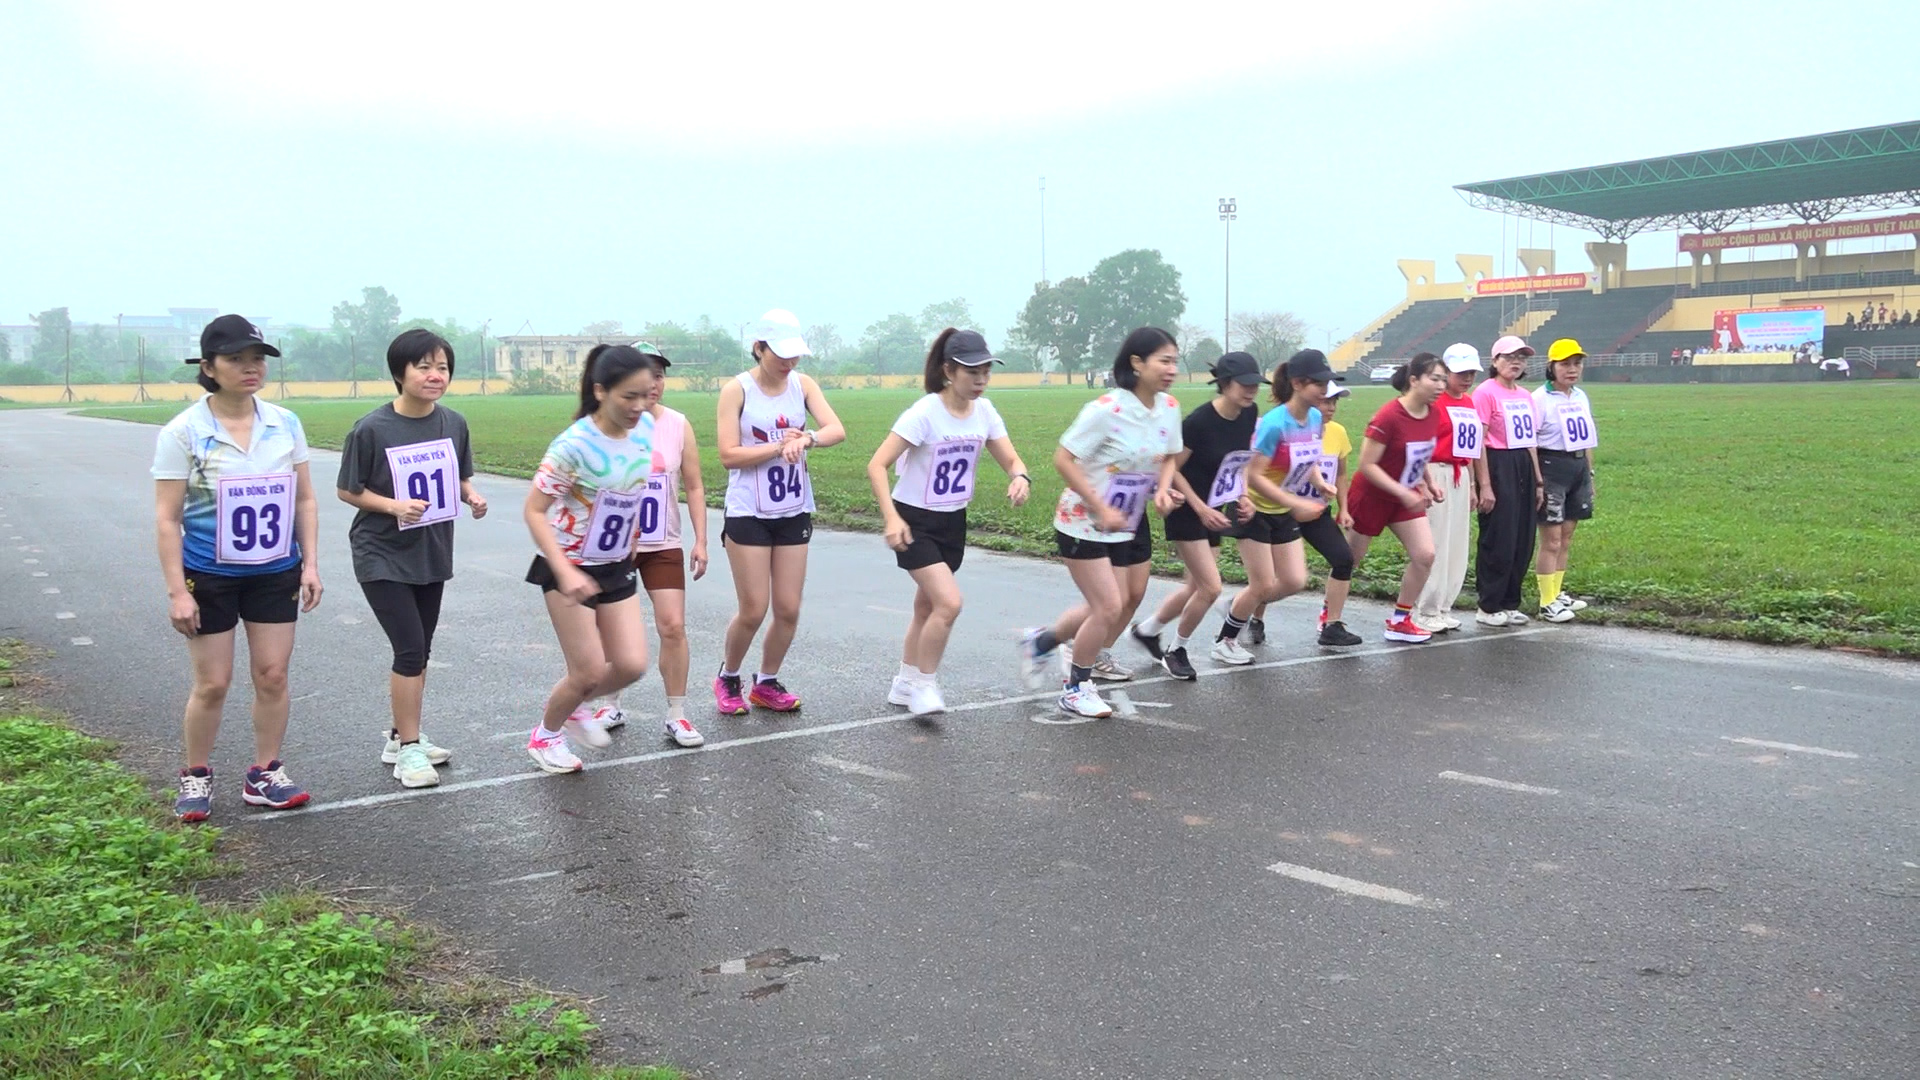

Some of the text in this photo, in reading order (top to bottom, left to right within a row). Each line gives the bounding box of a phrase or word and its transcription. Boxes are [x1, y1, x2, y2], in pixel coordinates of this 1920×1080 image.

[1729, 234, 1755, 246] CỘNG
[1757, 231, 1777, 243] HOÀ
[1795, 227, 1812, 240] HỘI
[1815, 224, 1836, 238] CHỦ
[1873, 220, 1896, 234] VIỆT
[1457, 422, 1477, 450] 88
[1512, 414, 1533, 440] 89
[1566, 416, 1589, 442] 90
[407, 468, 446, 513] 91
[767, 463, 802, 503] 84
[933, 458, 969, 496] 82
[231, 503, 281, 552] 93
[597, 512, 636, 551] 81
